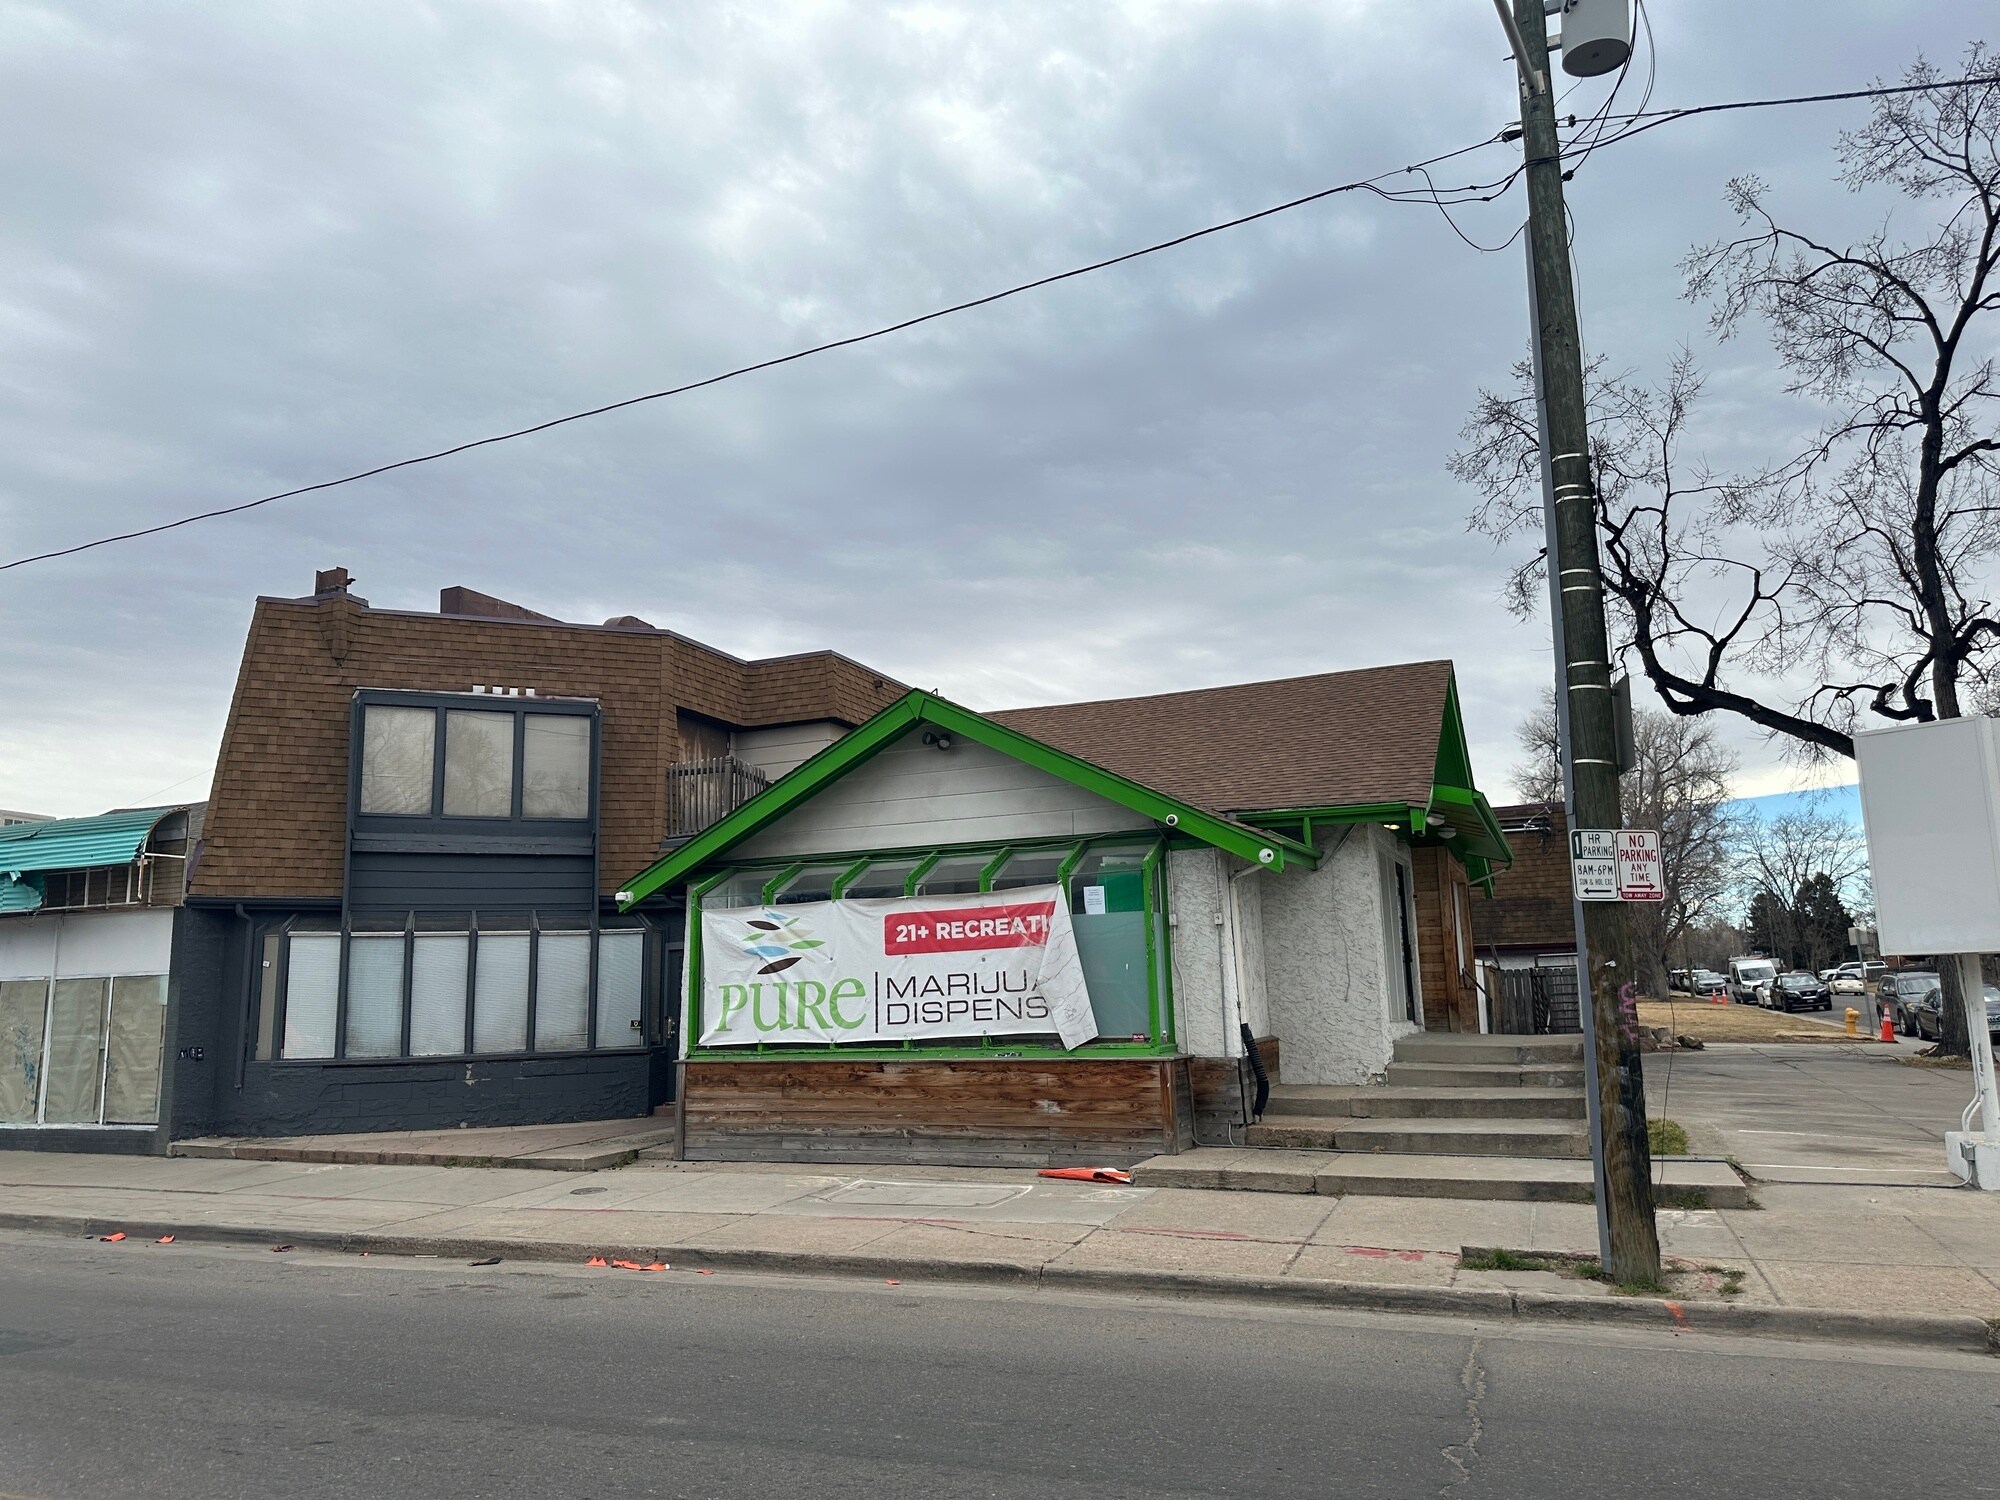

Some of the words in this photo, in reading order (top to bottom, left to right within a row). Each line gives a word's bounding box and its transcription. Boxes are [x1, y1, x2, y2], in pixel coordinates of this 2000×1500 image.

[1574, 835, 1580, 855] 1
[1588, 834, 1601, 844] HR
[1629, 835, 1645, 848] NO
[1583, 846, 1613, 857] PARKING
[1620, 849, 1657, 862] PARKING
[1577, 865, 1613, 875] 8AM-6PM
[1631, 863, 1648, 872] ANY
[1579, 878, 1588, 886] SUN
[1595, 878, 1604, 886] HOL
[1605, 878, 1614, 886] EXC
[1630, 873, 1651, 882] TIME
[896, 924, 929, 943] 21+
[936, 914, 1050, 940] RECREATI
[887, 996, 1049, 1026] DISPENS
